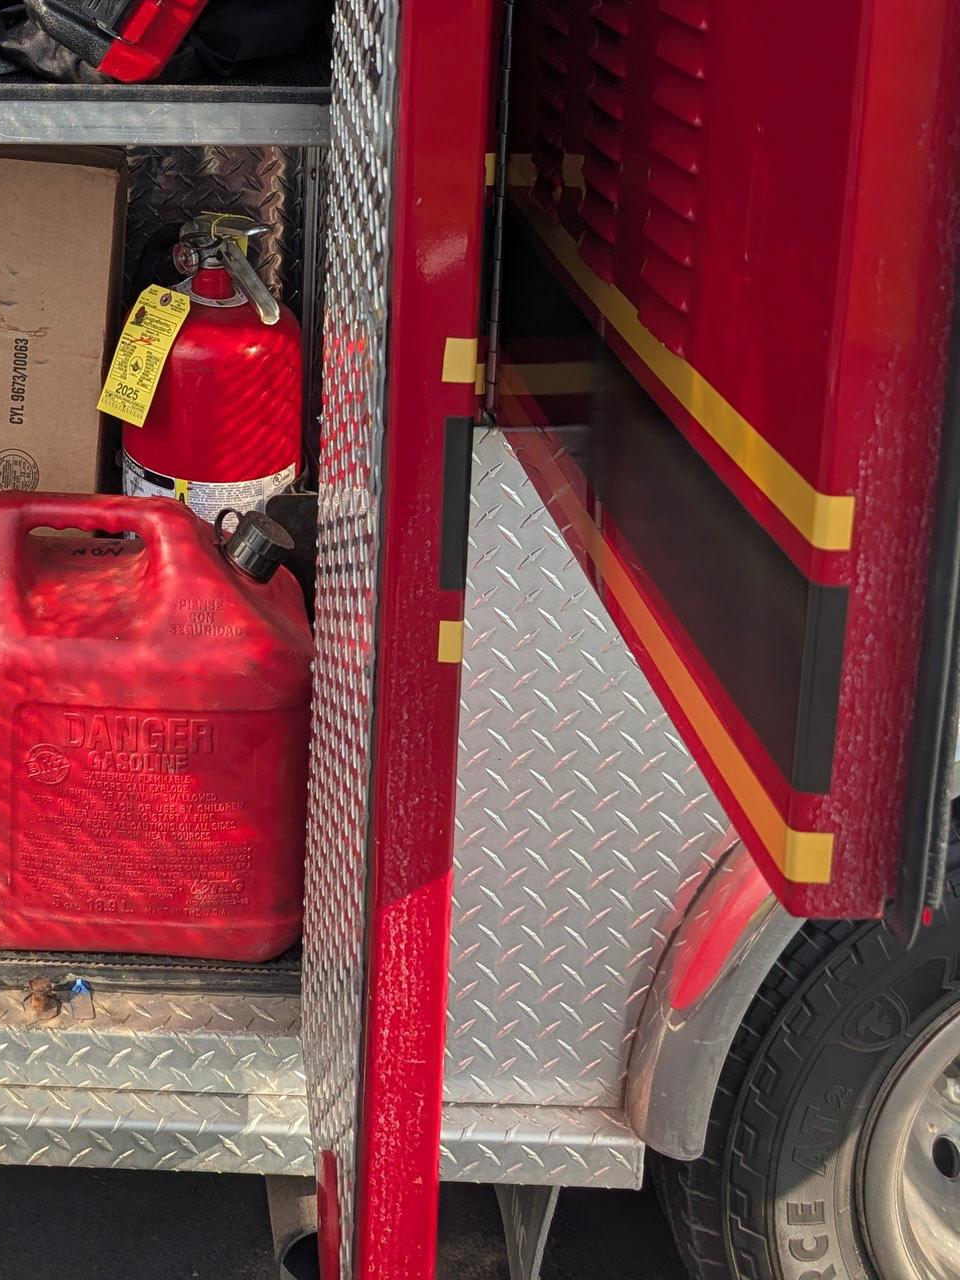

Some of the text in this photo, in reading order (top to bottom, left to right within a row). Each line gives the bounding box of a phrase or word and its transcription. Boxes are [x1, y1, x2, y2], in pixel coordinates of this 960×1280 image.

[10, 337, 29, 402] 9673/10063
[115, 382, 140, 401] 2025
[9, 404, 25, 425] CYL
[176, 599, 224, 610] PIENSE
[63, 712, 215, 754] DANGER
[88, 751, 189, 774] GASOLINE
[83, 771, 191, 783] EXTREMELY FLAMMABLE
[126, 782, 145, 791] CAN
[149, 784, 189, 793] EXPLODE
[162, 792, 217, 802] SWALLOWED
[58, 798, 77, 807] OUT
[82, 800, 97, 809] OF
[101, 801, 134, 811] REACH
[138, 803, 151, 812] OR
[156, 804, 175, 813] USE
[179, 804, 193, 813] BY
[93, 811, 109, 820] USE
[113, 812, 133, 821] GAS
[137, 813, 148, 821] TO
[151, 813, 179, 822] START
[130, 821, 175, 831] CAUTIONS
[179, 822, 192, 831] ON
[194, 822, 210, 831] ALL
[145, 832, 167, 840] HEAT
[171, 831, 211, 840] SOURCES
[52, 894, 61, 908] 5
[86, 898, 119, 912] 18.9
[184, 908, 201, 917] THE
